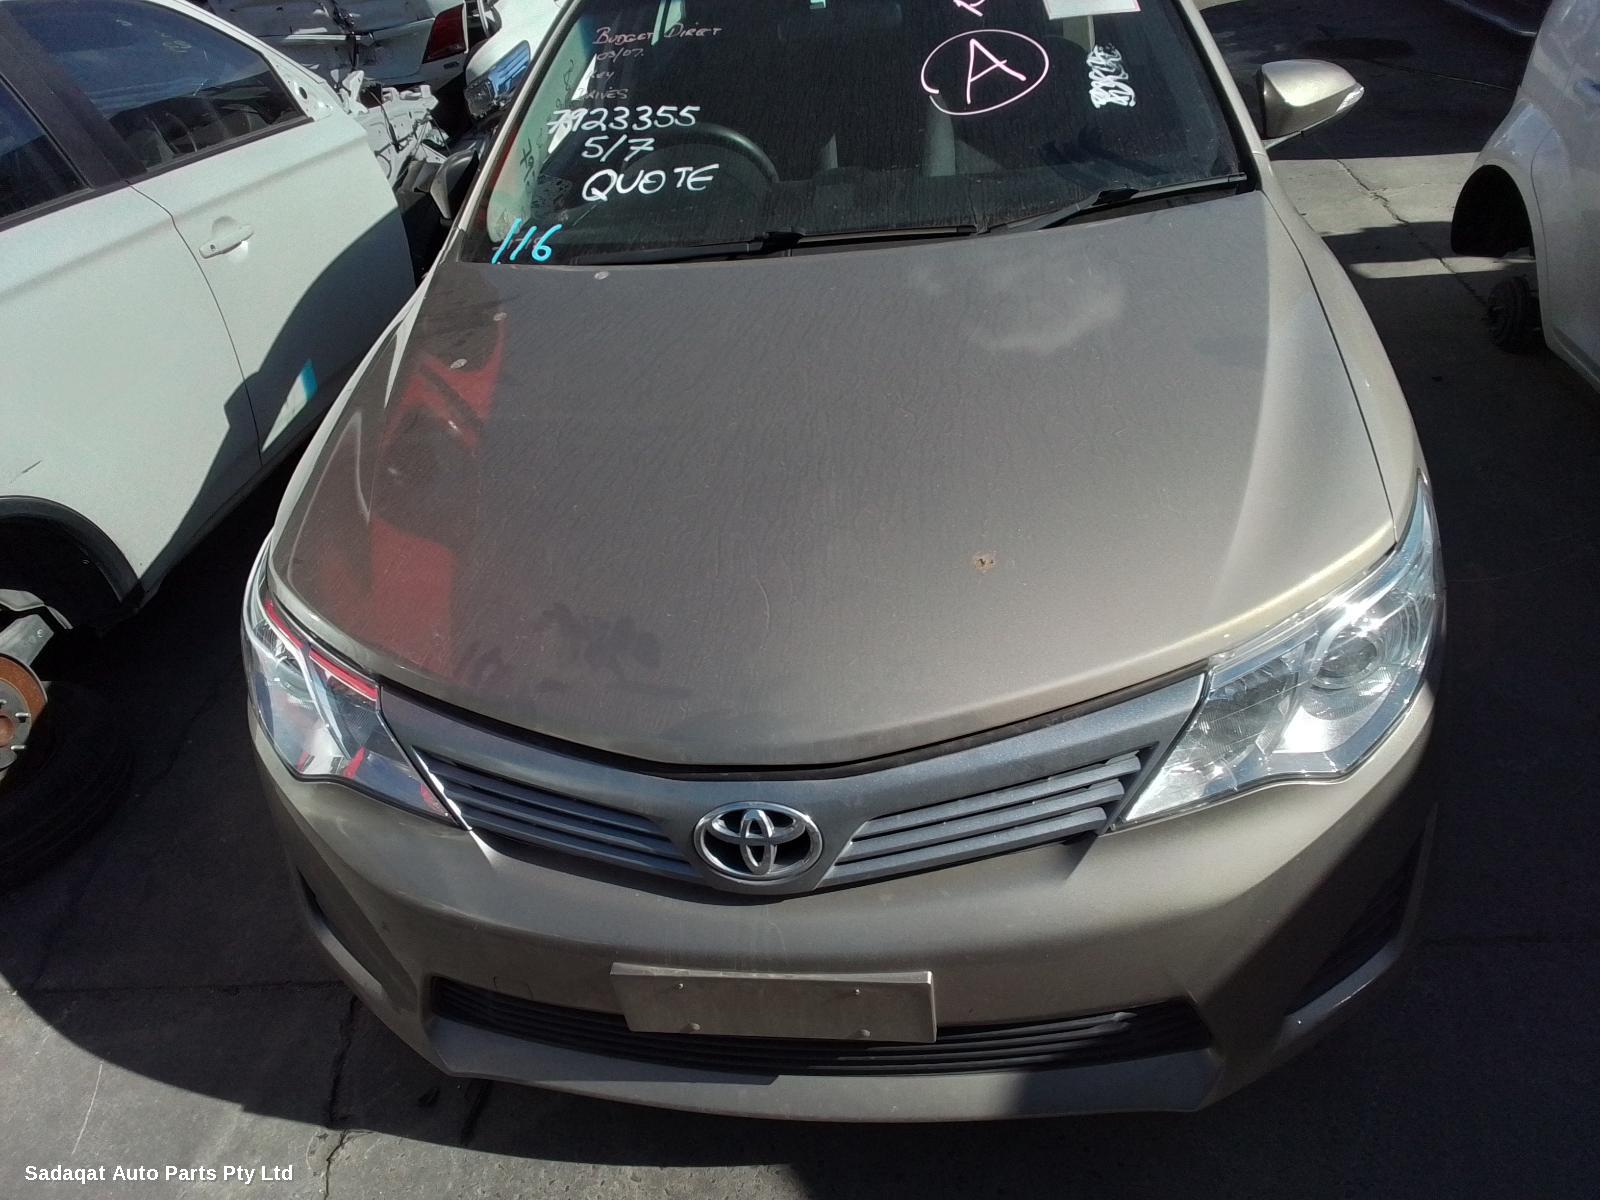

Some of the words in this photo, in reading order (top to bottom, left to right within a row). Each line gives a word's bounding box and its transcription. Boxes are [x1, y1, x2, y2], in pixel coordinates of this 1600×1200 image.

[966, 39, 1026, 104] A
[581, 134, 655, 162] 5/7
[581, 163, 720, 202] QUOTE
[491, 217, 563, 265] 116
